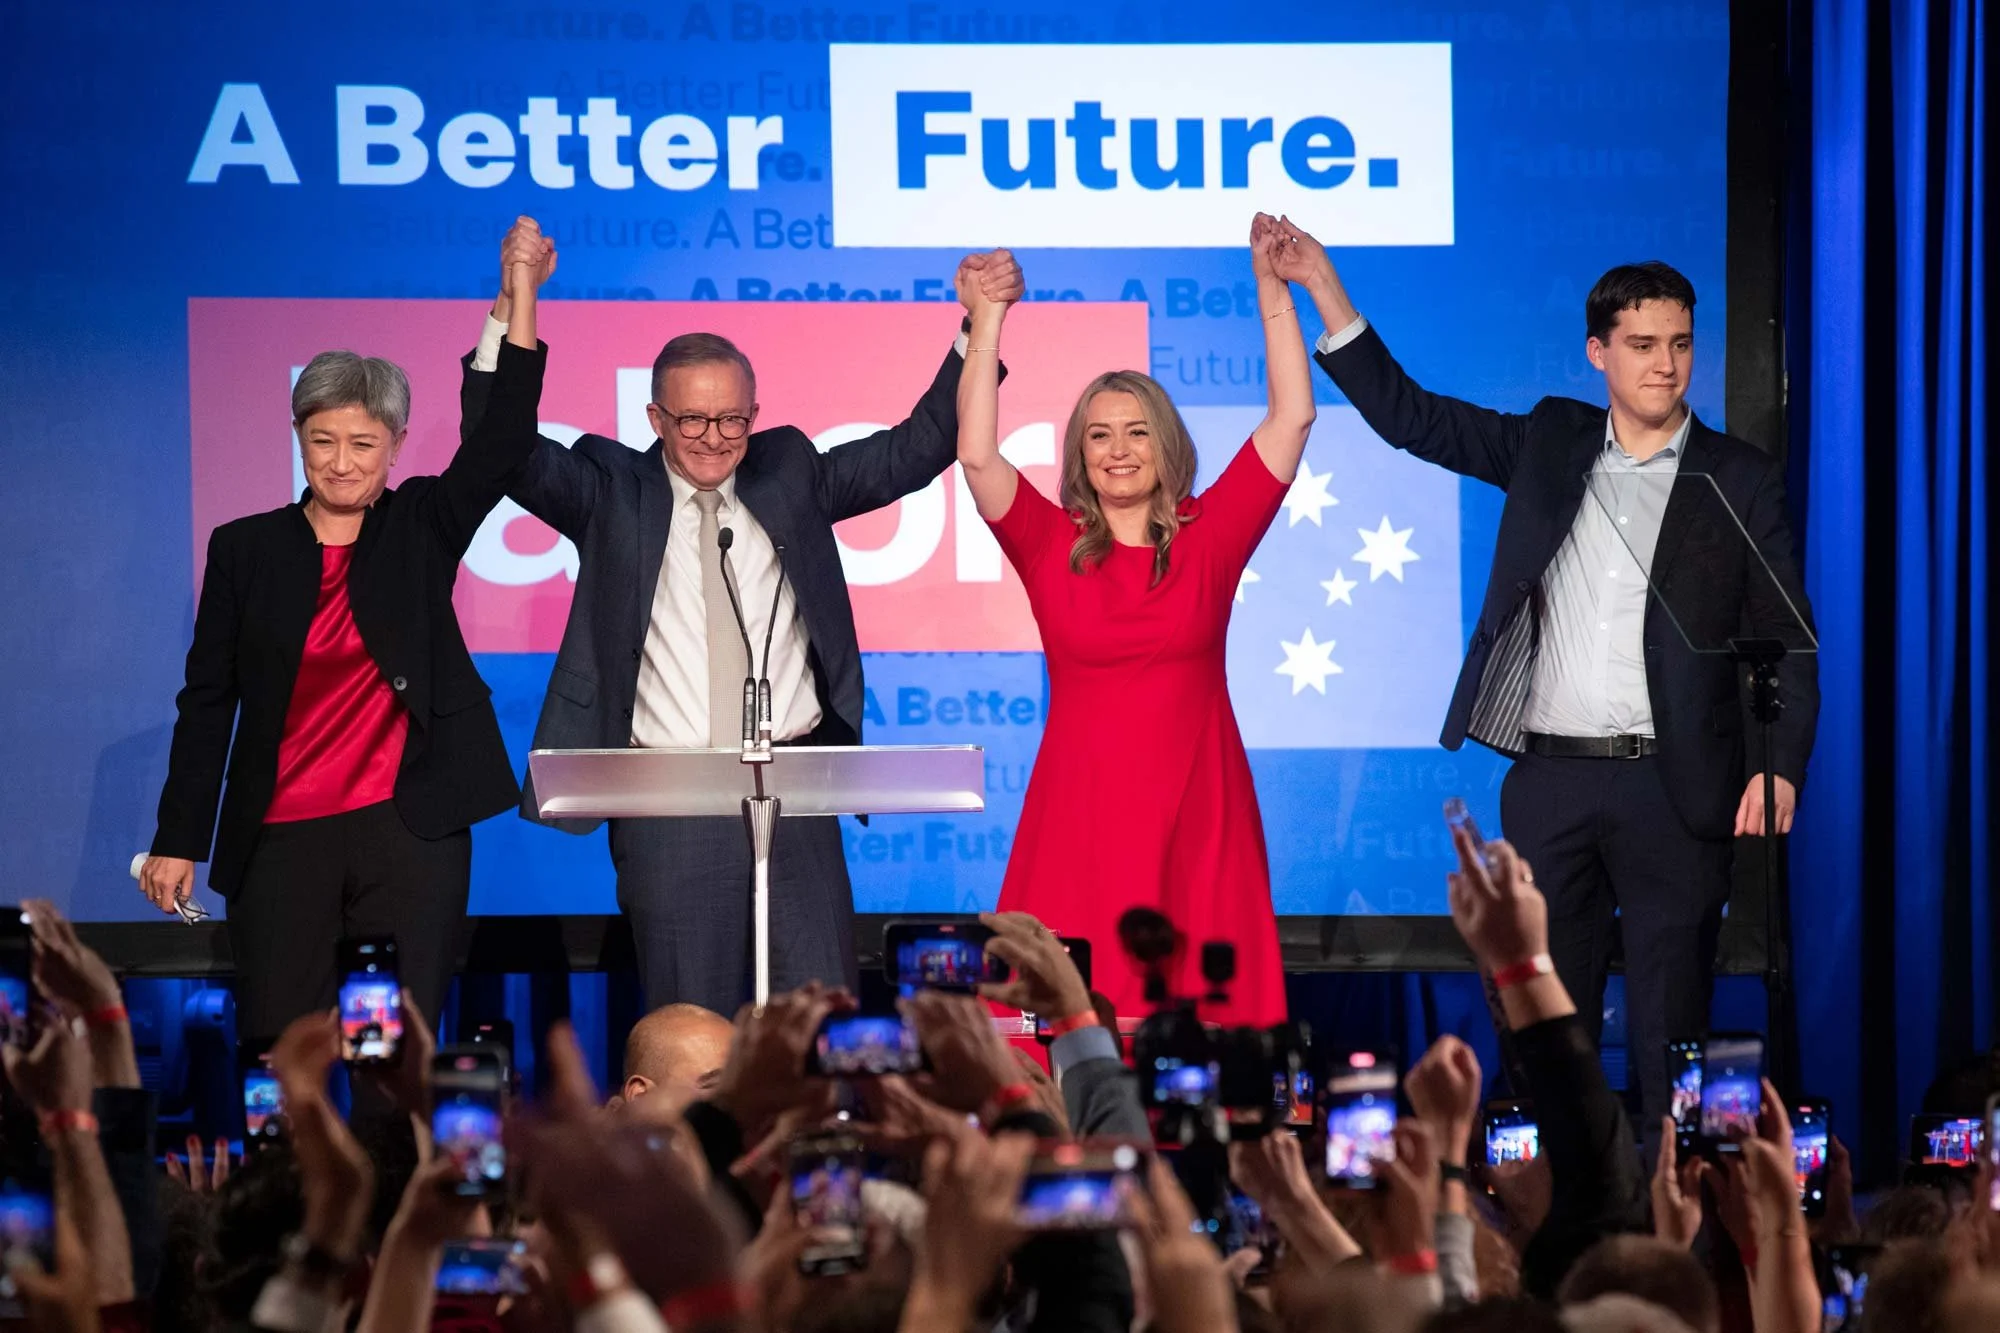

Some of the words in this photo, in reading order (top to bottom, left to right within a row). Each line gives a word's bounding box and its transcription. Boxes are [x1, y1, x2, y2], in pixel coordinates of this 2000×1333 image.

[187, 82, 301, 186] A
[335, 83, 783, 191] Better
[894, 89, 1399, 192] Future.
[704, 208, 741, 249] A
